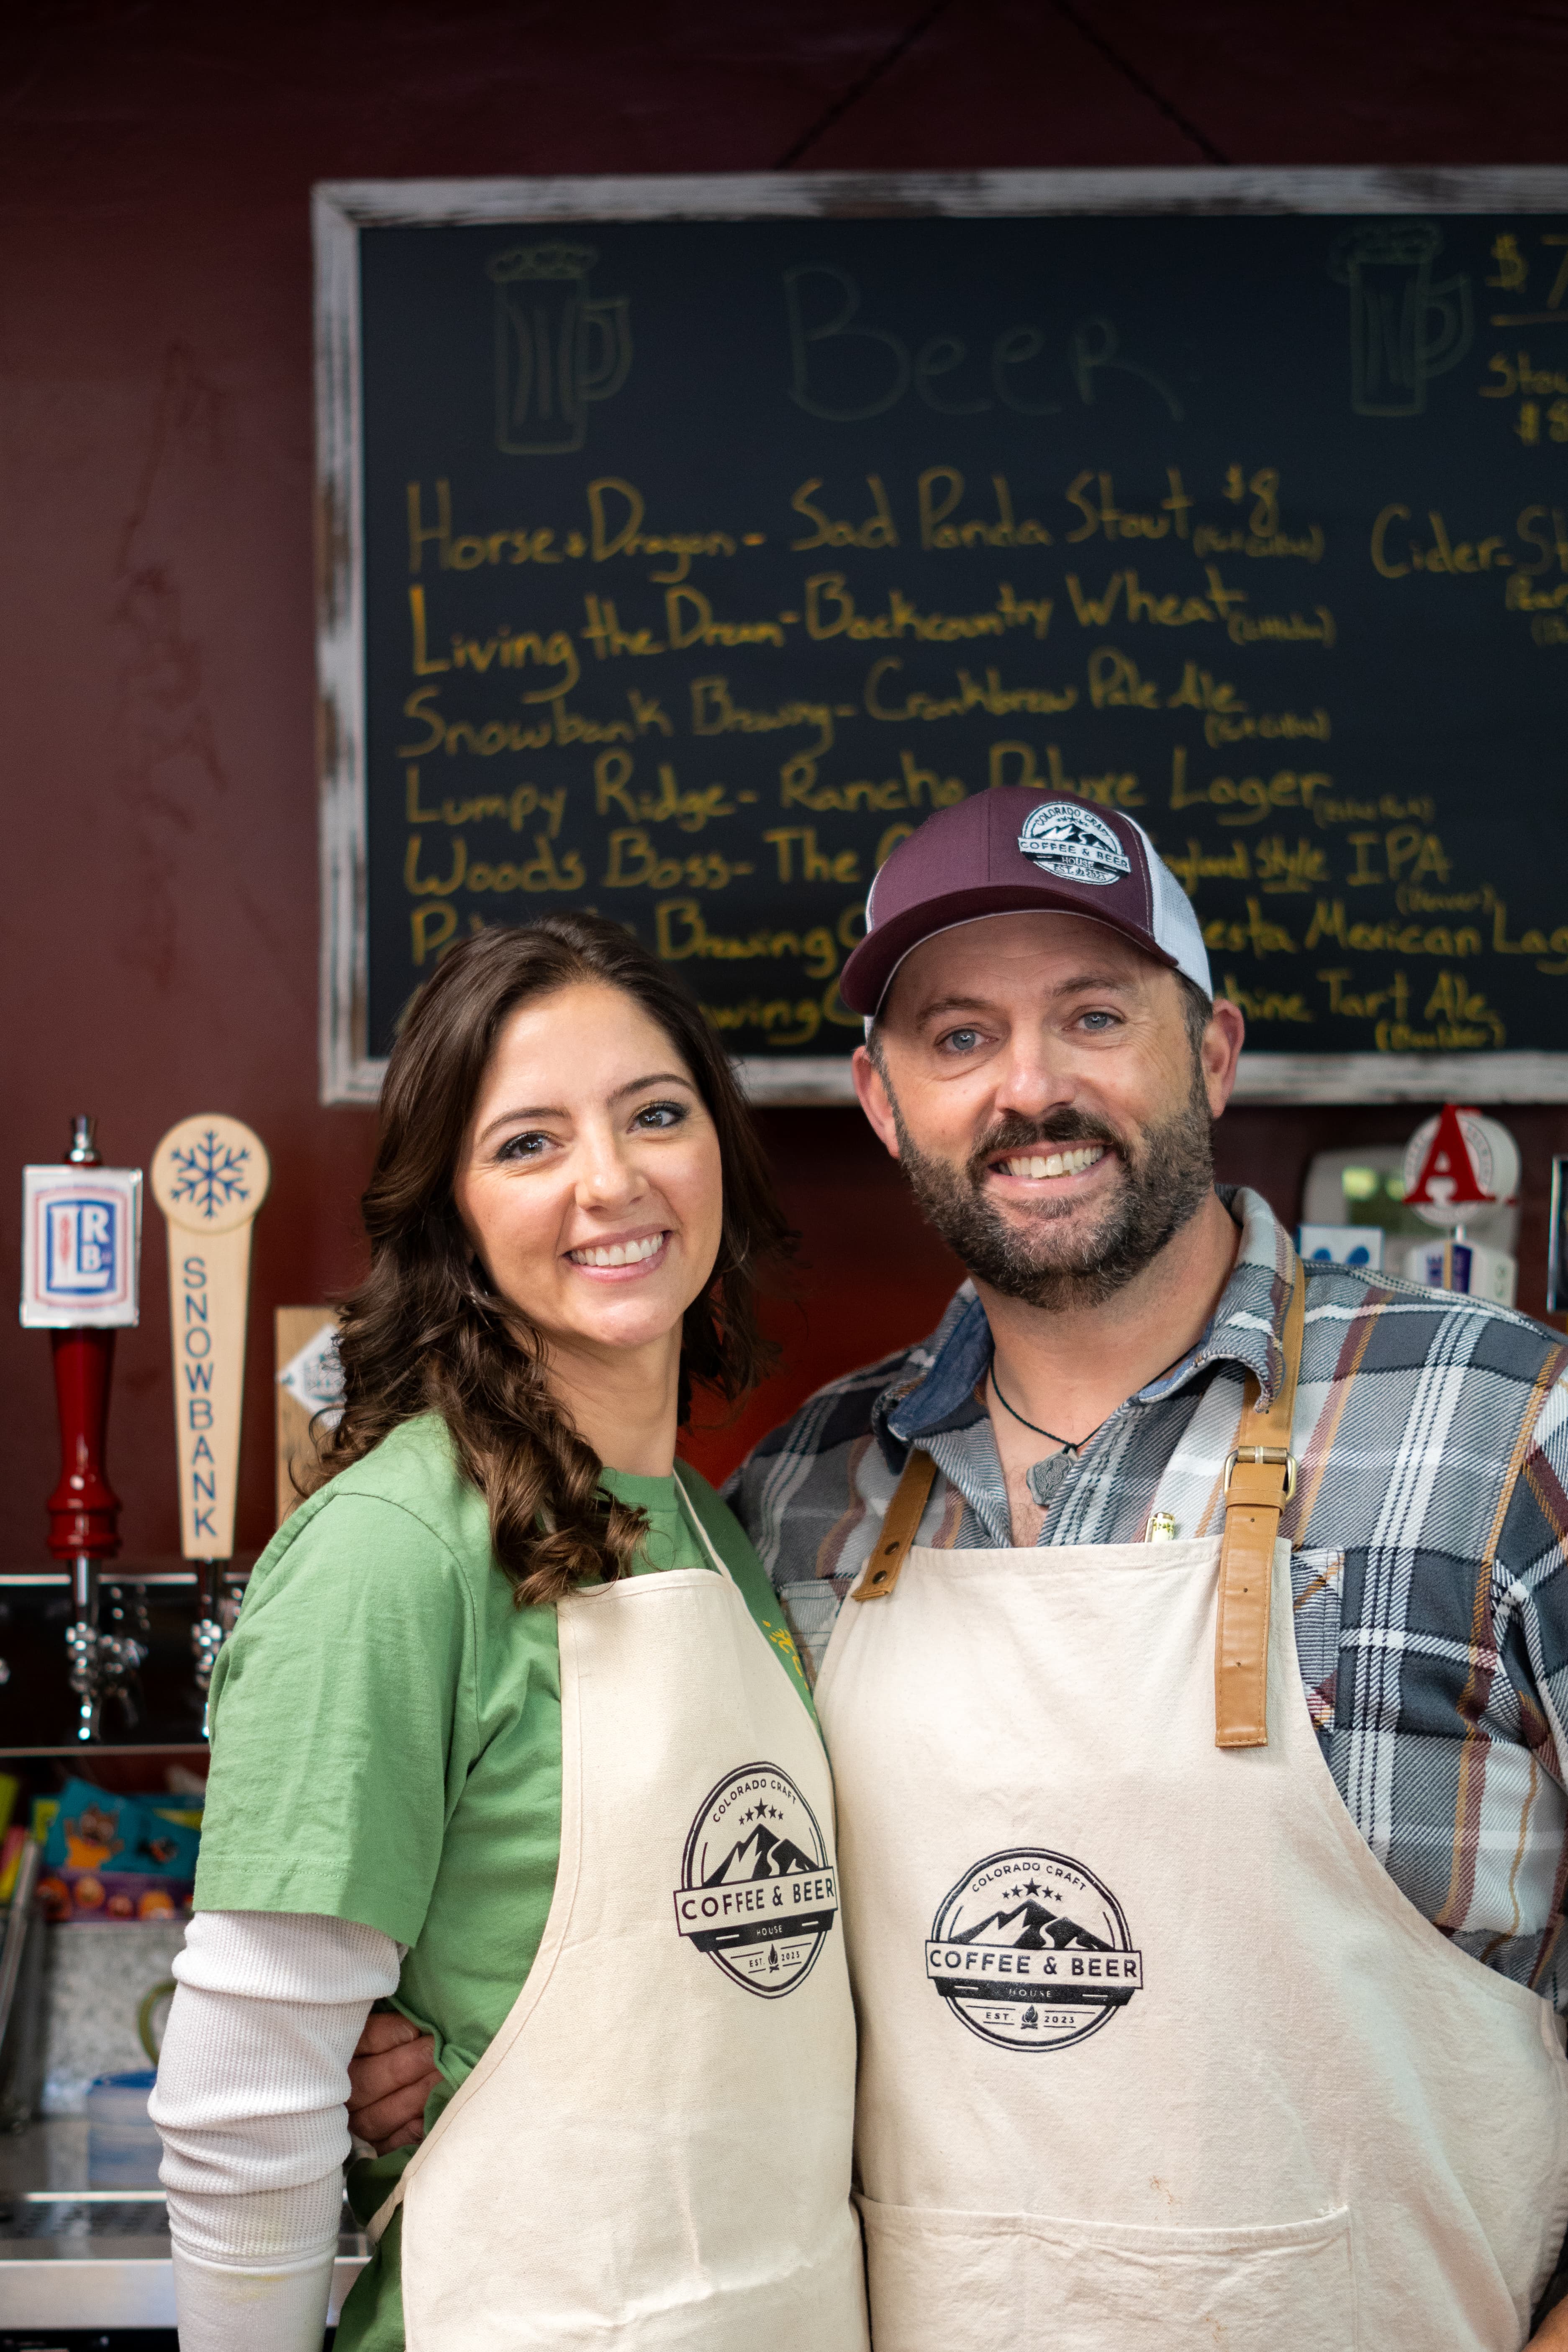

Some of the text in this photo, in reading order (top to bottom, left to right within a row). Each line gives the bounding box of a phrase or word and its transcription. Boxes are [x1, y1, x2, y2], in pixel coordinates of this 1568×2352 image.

[791, 473, 901, 551] Sad
[918, 465, 1053, 550] Panda
[1065, 465, 1195, 544] Stout
[408, 585, 580, 704] Living
[581, 592, 667, 659] the
[1065, 563, 1247, 628] Wheat
[396, 685, 673, 757] Snowbank
[1168, 659, 1247, 713] Ale
[406, 764, 567, 838] Lumpy
[1169, 745, 1333, 826] Lager
[1035, 807, 1081, 826] COLORADO
[403, 835, 586, 896] Woods
[764, 826, 860, 884] The
[1346, 825, 1452, 887] IPA
[1020, 841, 1128, 868] COFFEE & BEER
[1062, 857, 1094, 868] HOUSE
[1316, 967, 1411, 1021] Tart
[1424, 969, 1494, 1022] Ale
[184, 1257, 216, 1537] SNOWBANK
[713, 1779, 796, 1822] COLORADO CRAFT
[972, 1862, 1086, 1892] COLORADO CRAFT
[681, 1877, 834, 1920] COFFEE & BEER
[757, 1925, 783, 1936] HOUSE
[749, 1951, 800, 1967] EST. 2023
[930, 1950, 1137, 1978] COFFEE & BEER
[1009, 1988, 1052, 1998] HOUSE
[986, 2012, 1013, 2021] EST.
